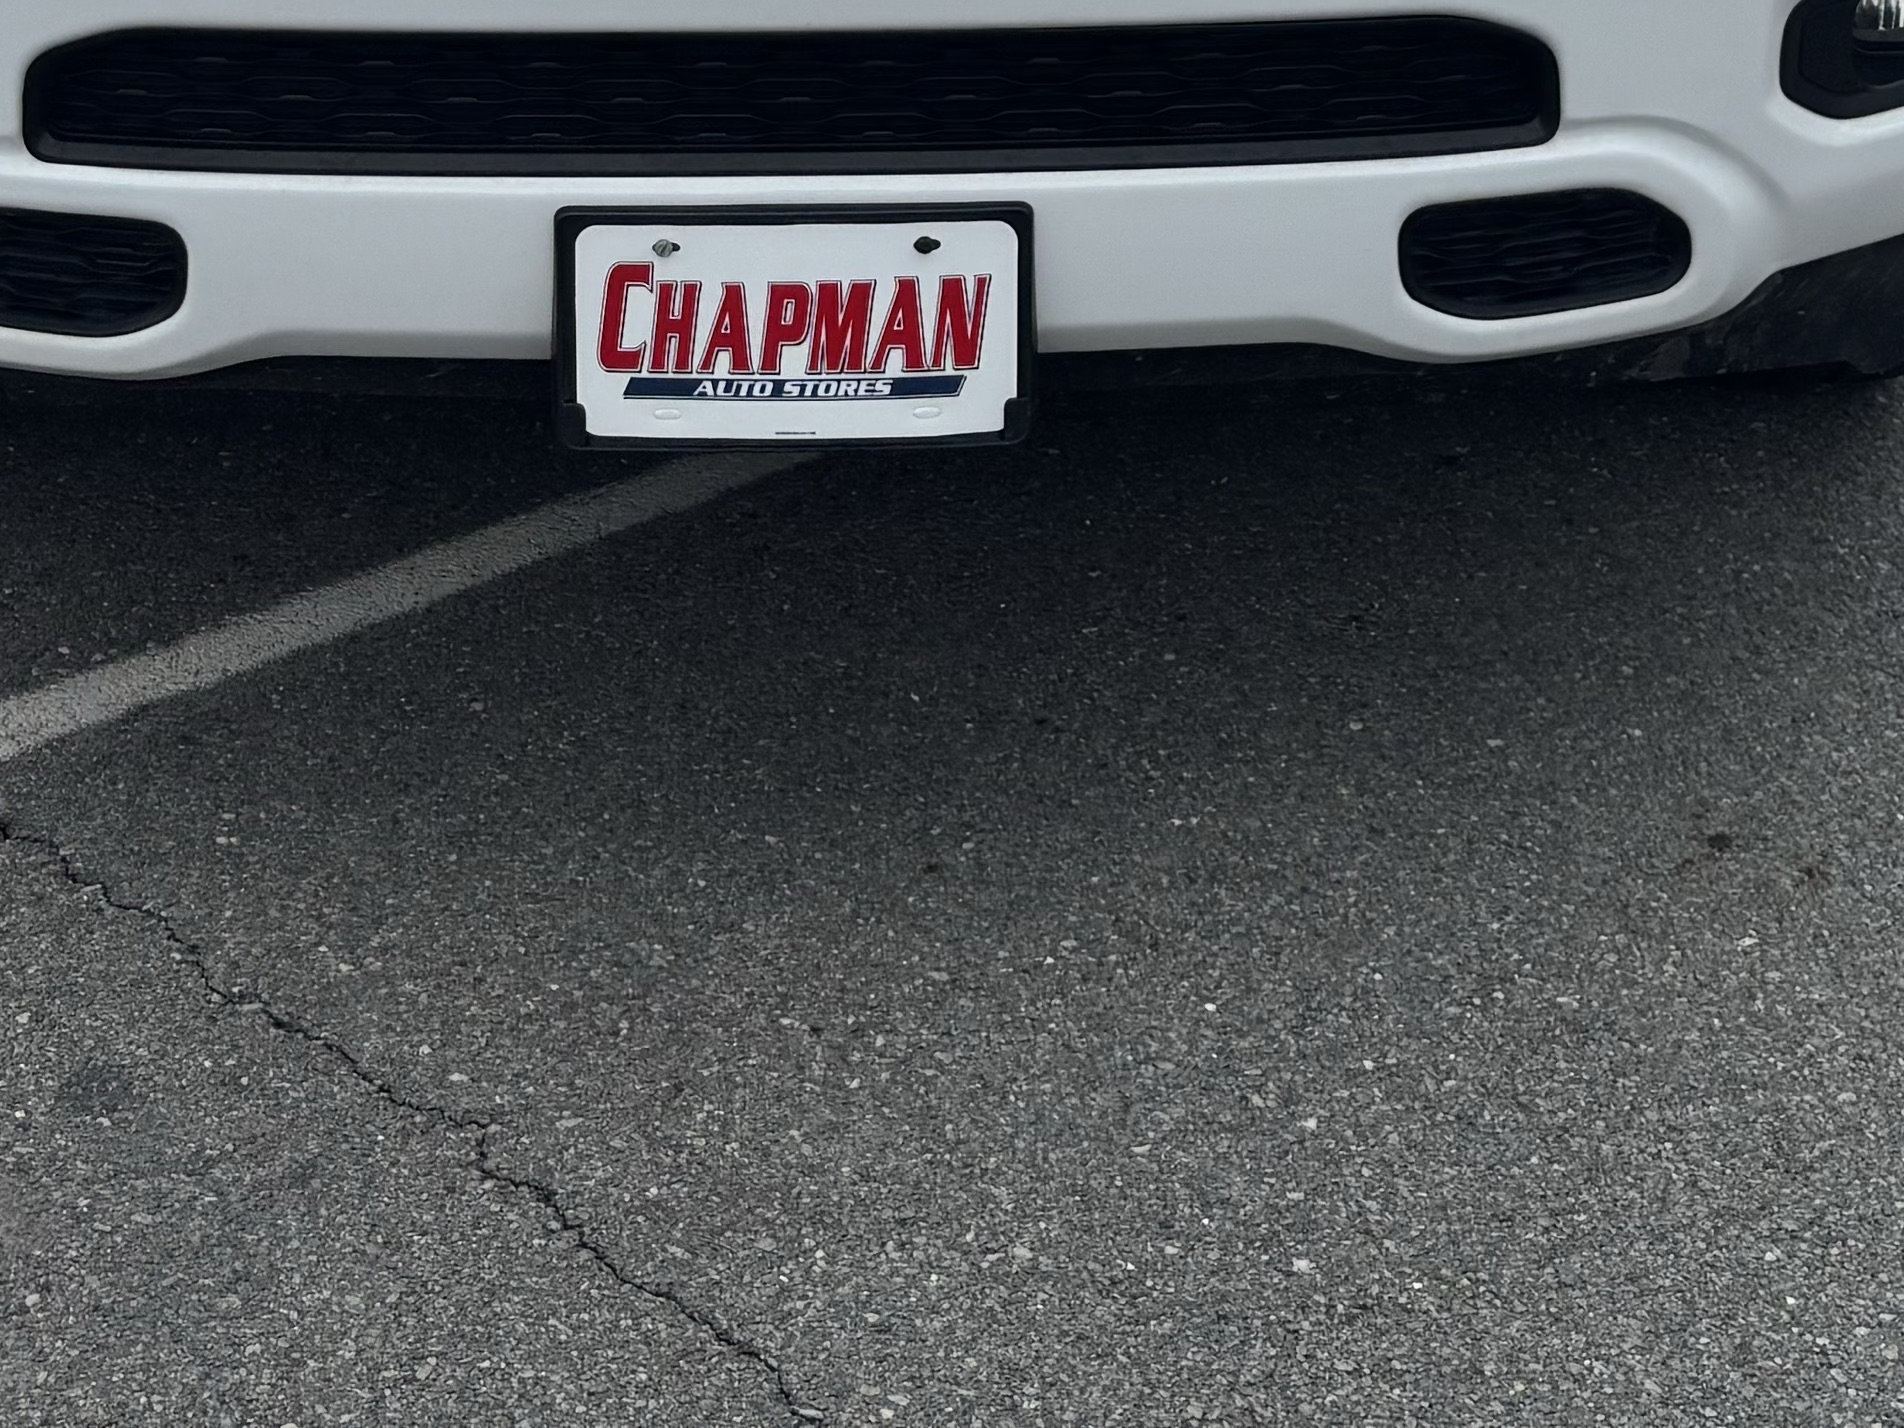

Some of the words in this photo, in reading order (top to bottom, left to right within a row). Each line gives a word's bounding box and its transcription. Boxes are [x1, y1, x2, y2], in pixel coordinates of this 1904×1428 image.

[596, 261, 992, 375] CHAPMAN
[693, 380, 773, 397] AUTO
[782, 379, 893, 397] STORES
